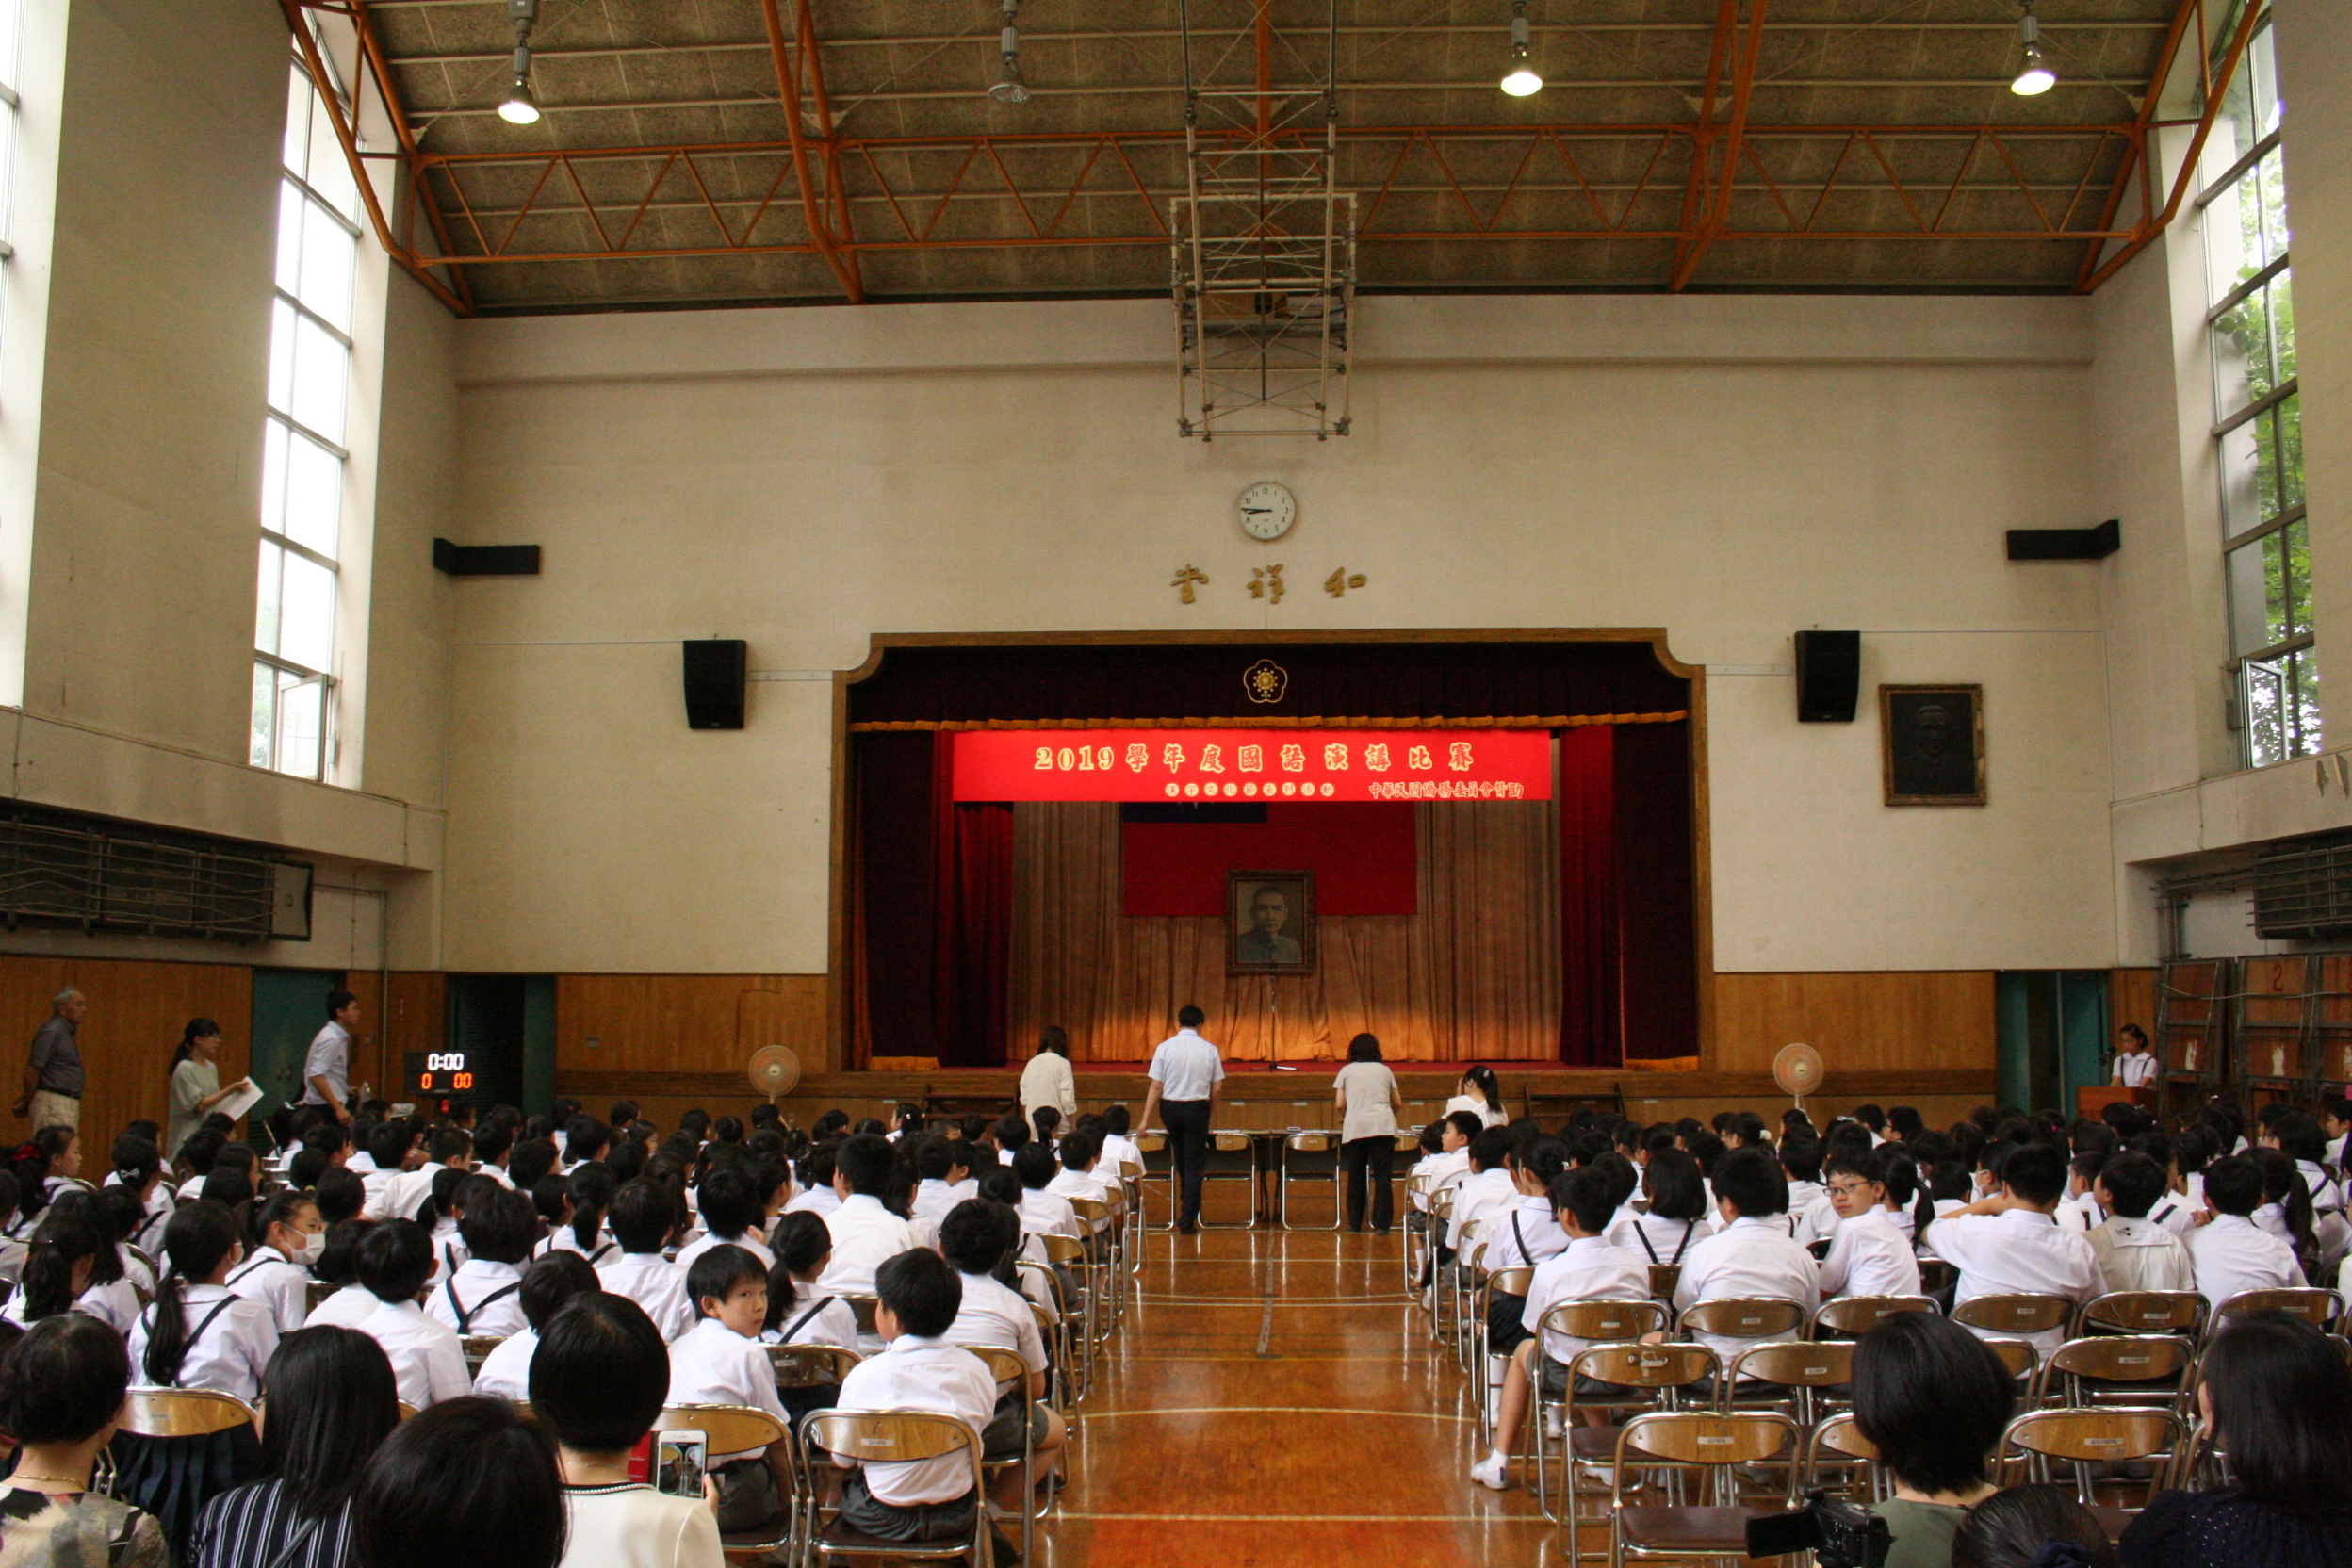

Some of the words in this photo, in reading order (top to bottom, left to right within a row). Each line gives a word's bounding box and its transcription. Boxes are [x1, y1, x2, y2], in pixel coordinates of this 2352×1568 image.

[2272, 963, 2284, 992] 2
[428, 1053, 465, 1070] 0:00
[421, 1072, 432, 1089] 0
[453, 1072, 472, 1089] 00
